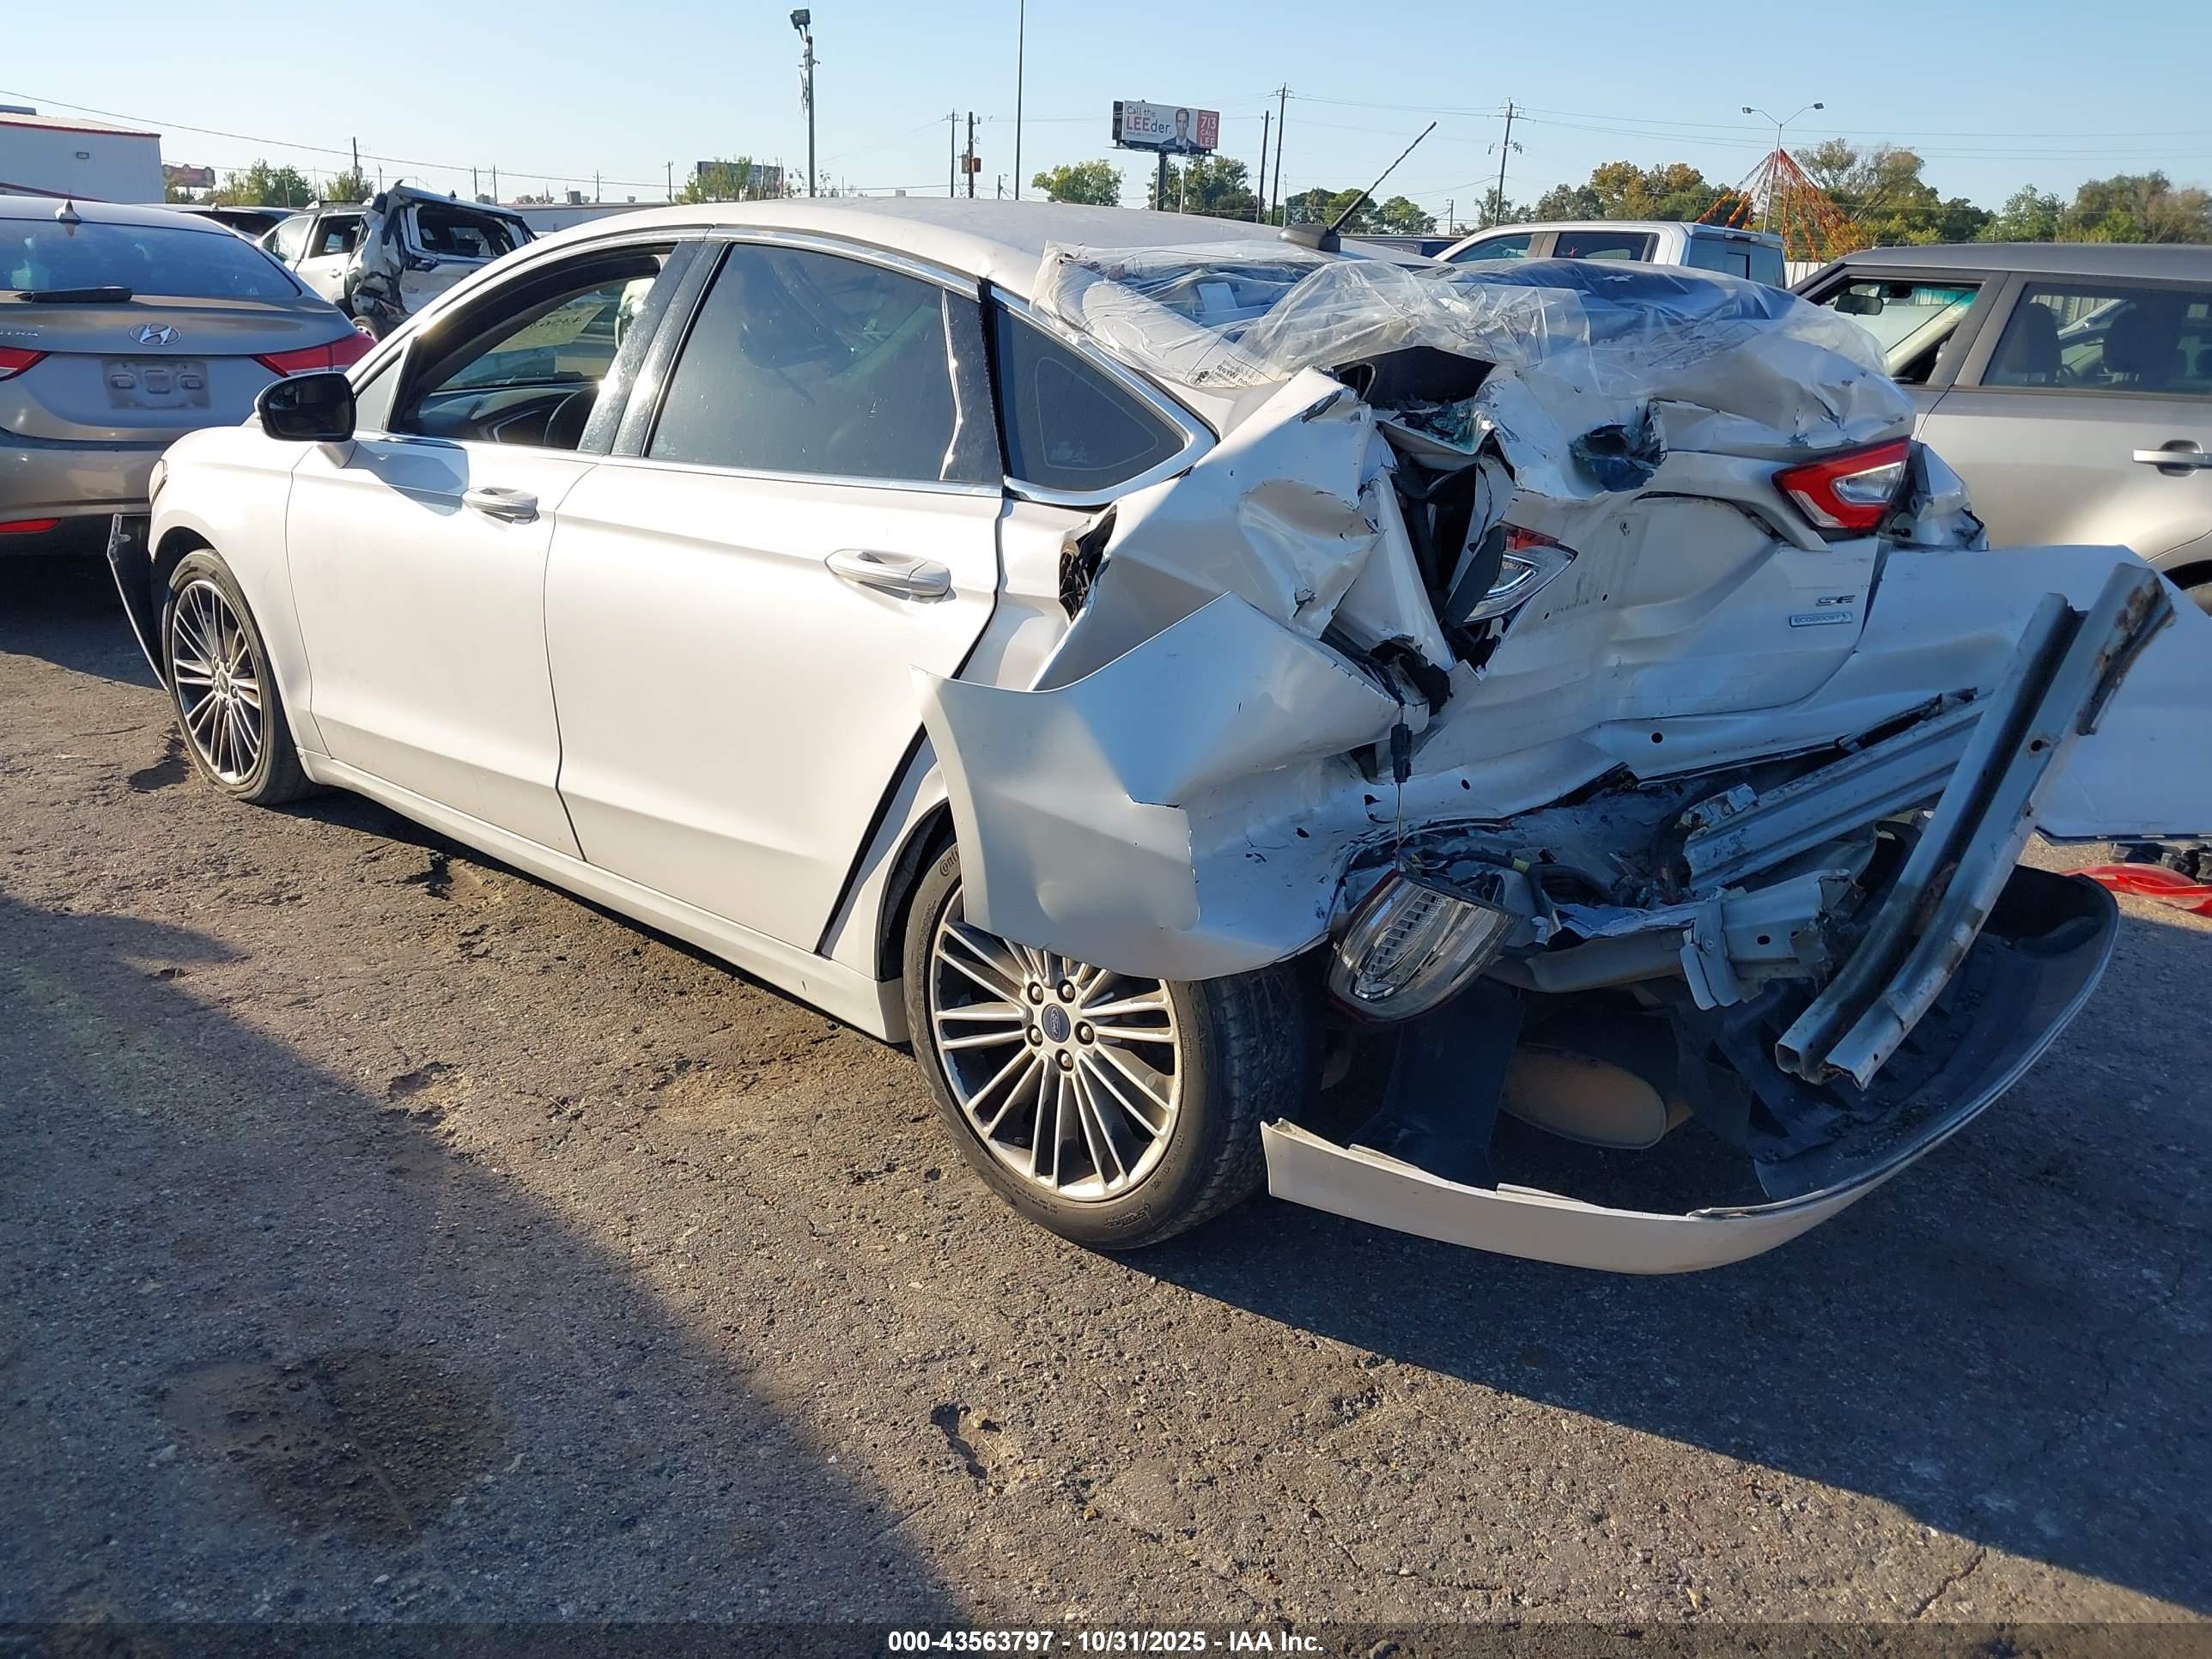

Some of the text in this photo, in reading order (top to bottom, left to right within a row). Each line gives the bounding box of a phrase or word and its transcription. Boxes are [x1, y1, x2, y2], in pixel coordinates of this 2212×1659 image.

[1127, 106, 1141, 115] Call
[1127, 115, 1172, 134] LEEder.
[1200, 116, 1217, 130] 713
[1200, 129, 1216, 137] CALL
[1200, 137, 1216, 148] LEE
[1815, 594, 1855, 606] SE
